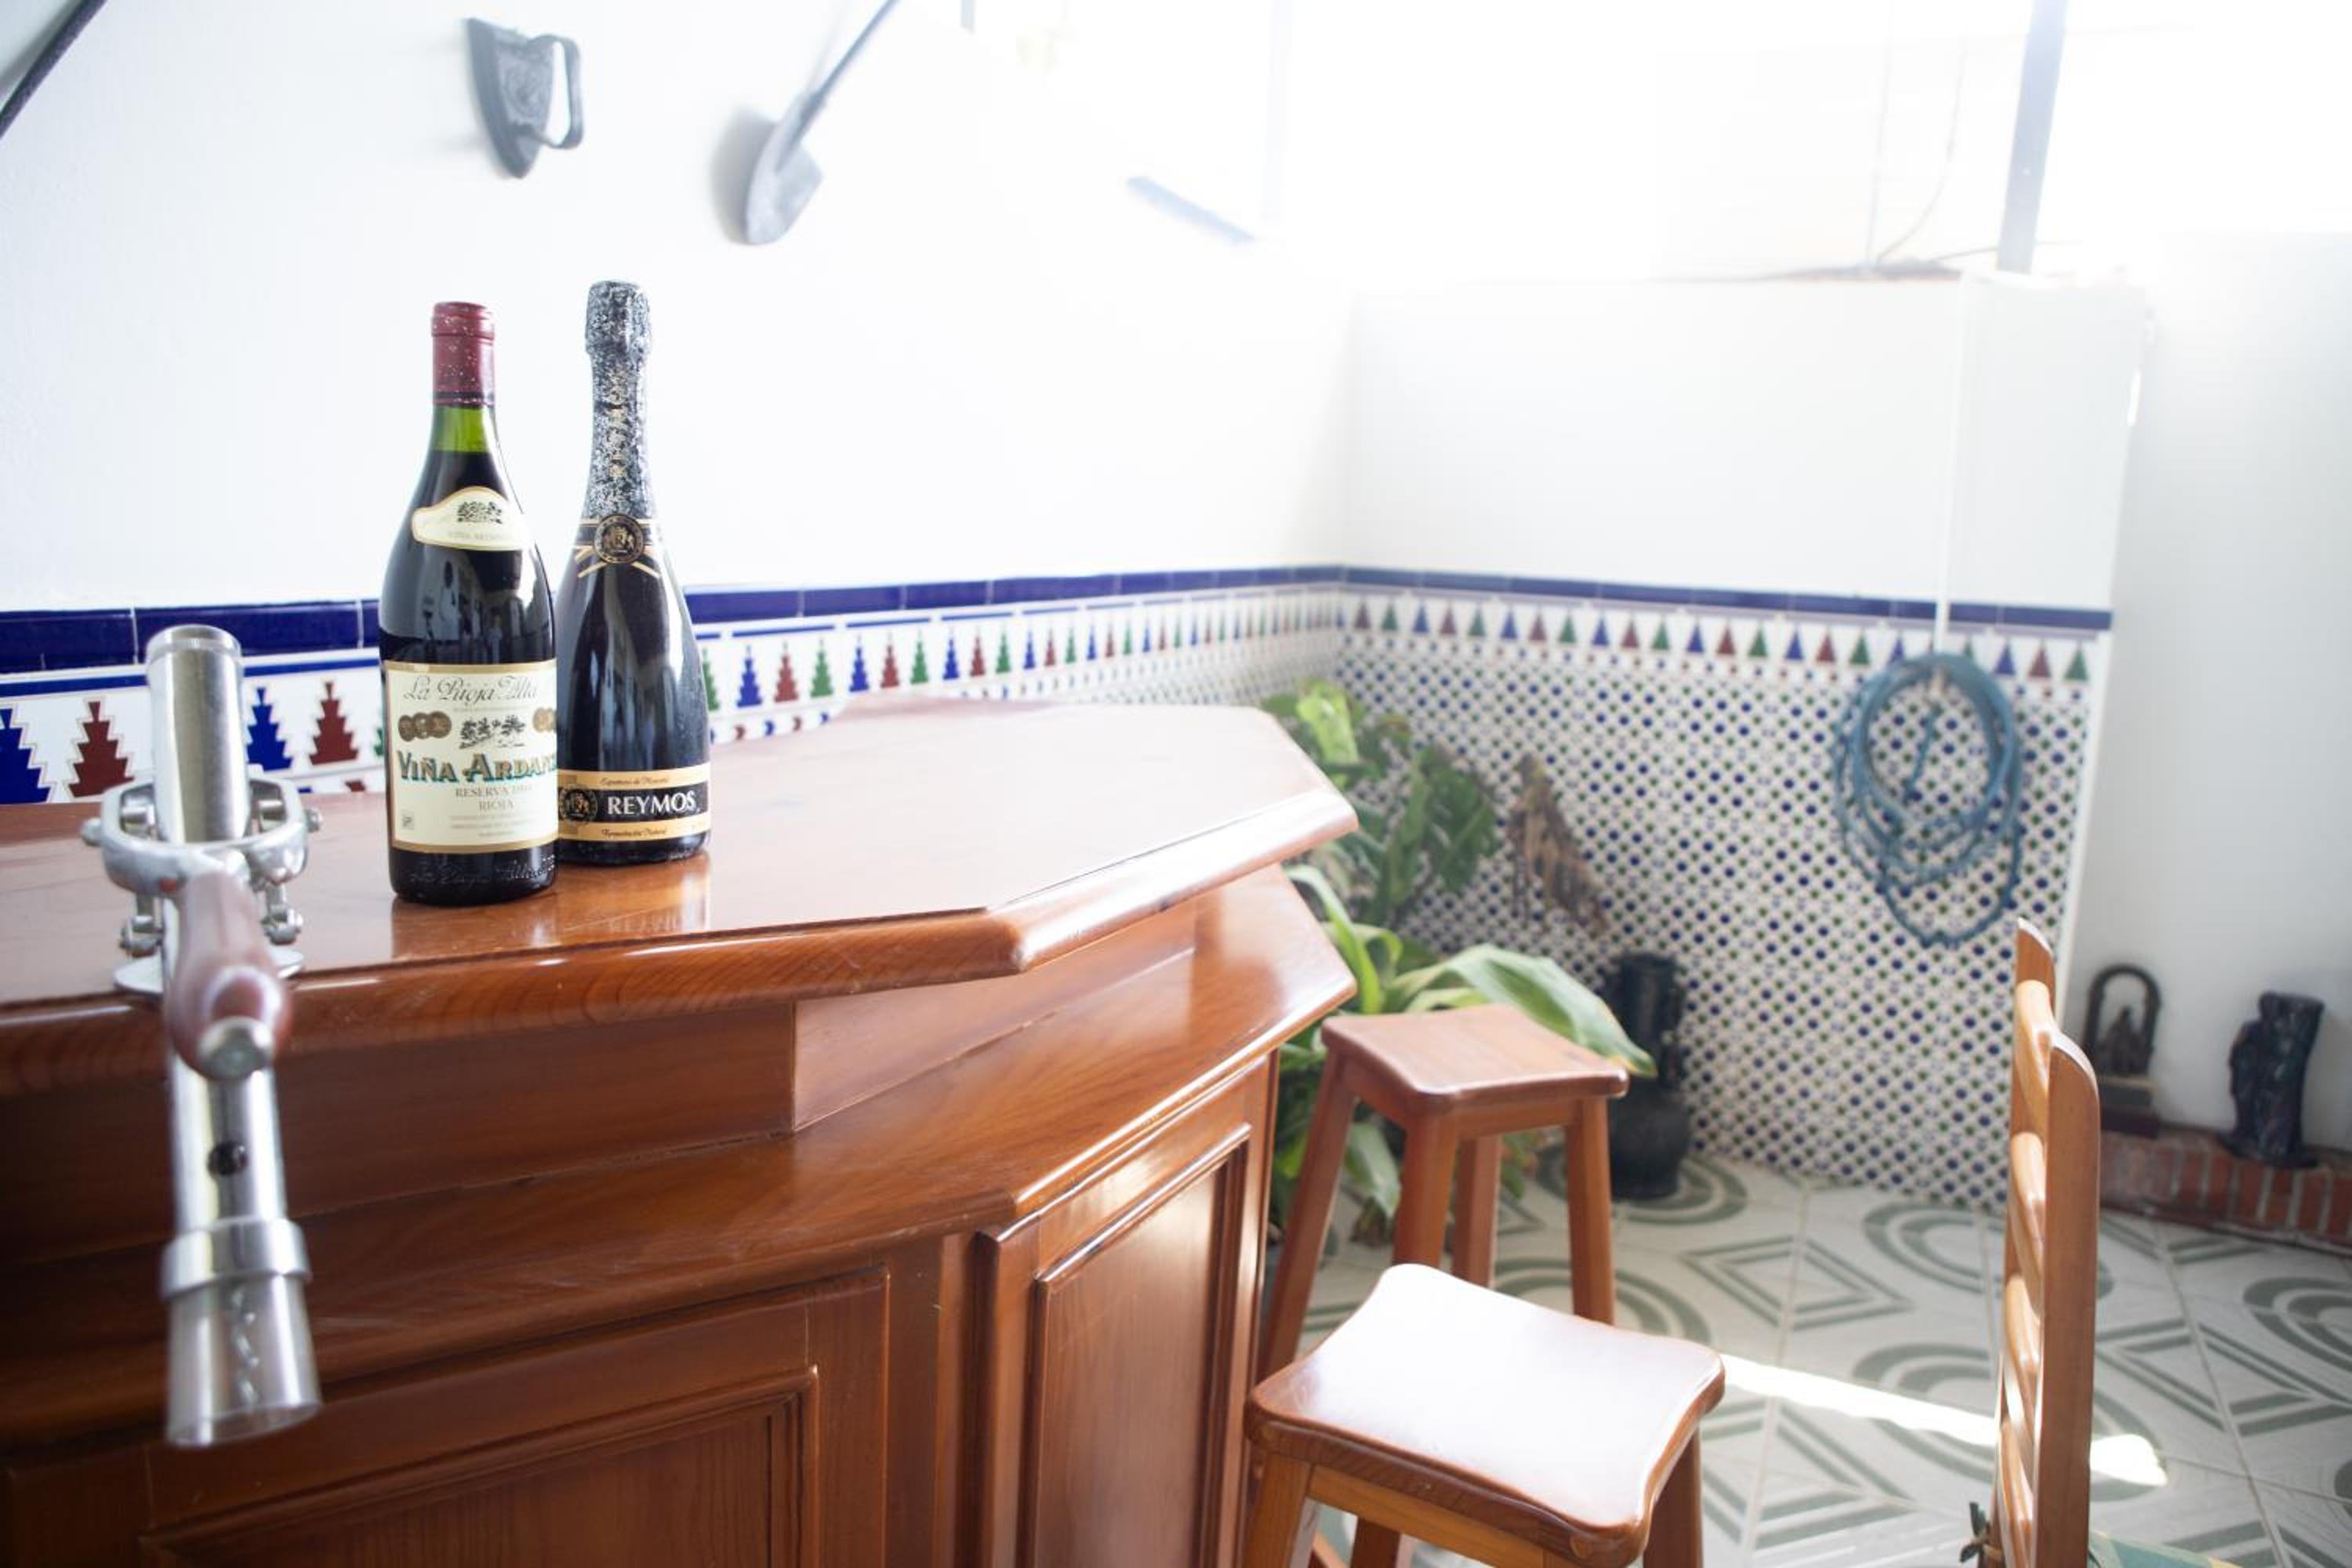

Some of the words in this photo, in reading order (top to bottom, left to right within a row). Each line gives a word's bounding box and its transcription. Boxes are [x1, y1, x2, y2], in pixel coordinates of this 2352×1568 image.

[403, 675, 431, 700] La
[437, 676, 495, 706] Rioja
[397, 750, 459, 782] VIÑA
[456, 786, 510, 797] RESERVA
[608, 789, 697, 815] REYMOS
